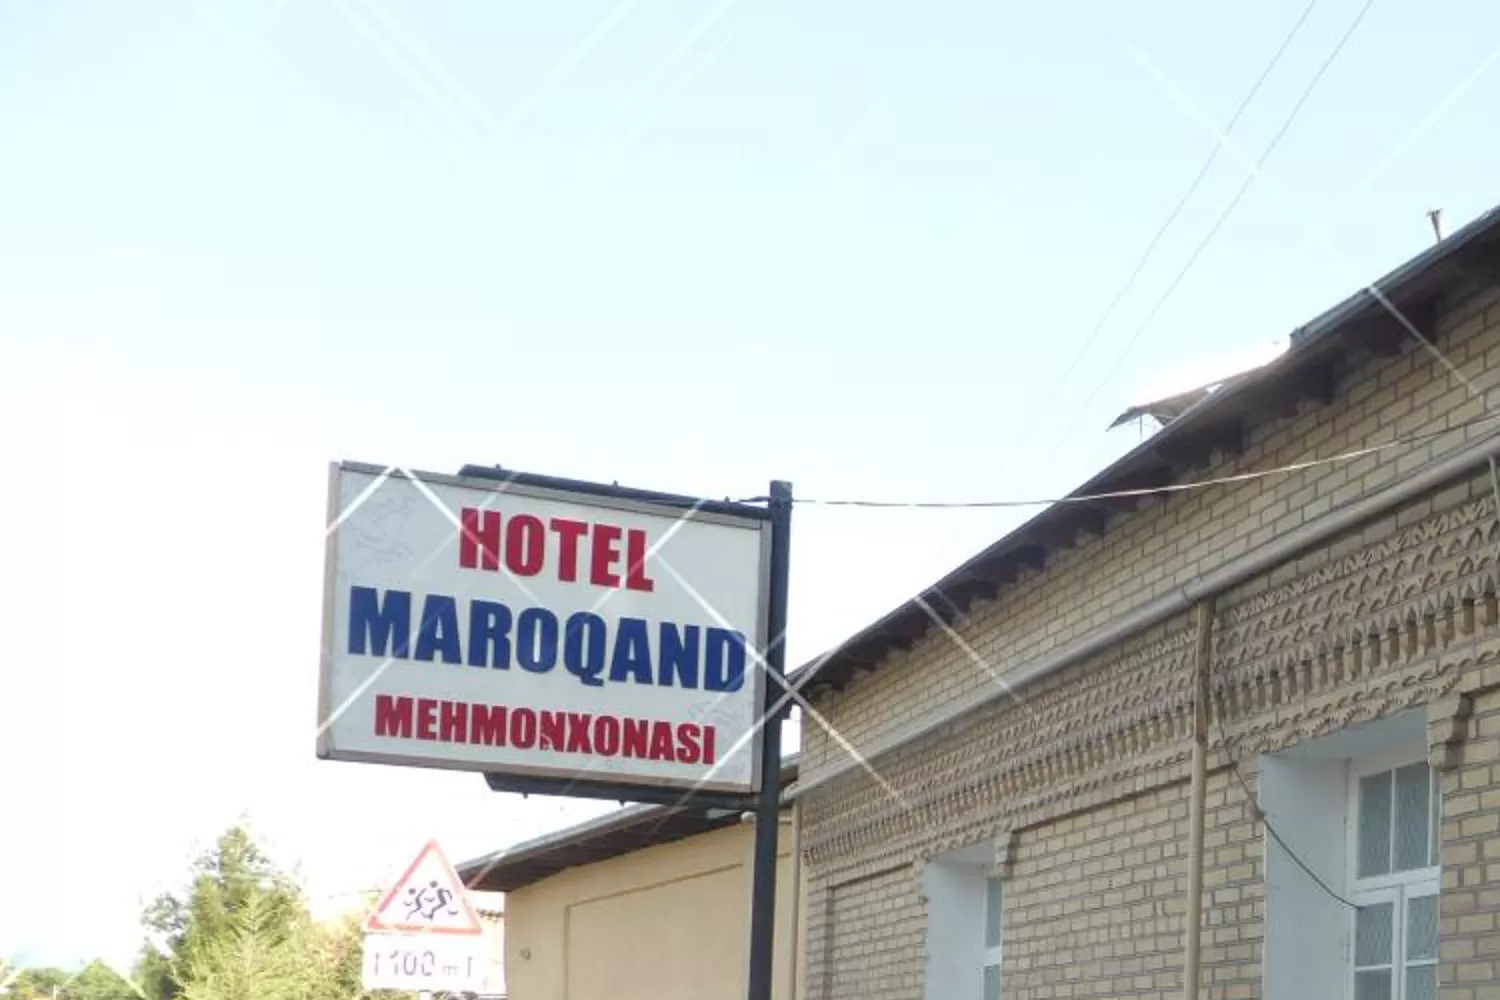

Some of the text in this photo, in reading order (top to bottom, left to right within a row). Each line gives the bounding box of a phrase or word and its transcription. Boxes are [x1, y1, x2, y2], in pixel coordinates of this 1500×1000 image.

[459, 506, 654, 593] HOTEL
[348, 585, 746, 692] MAROQAND
[375, 694, 716, 765] MEHMONXONASI
